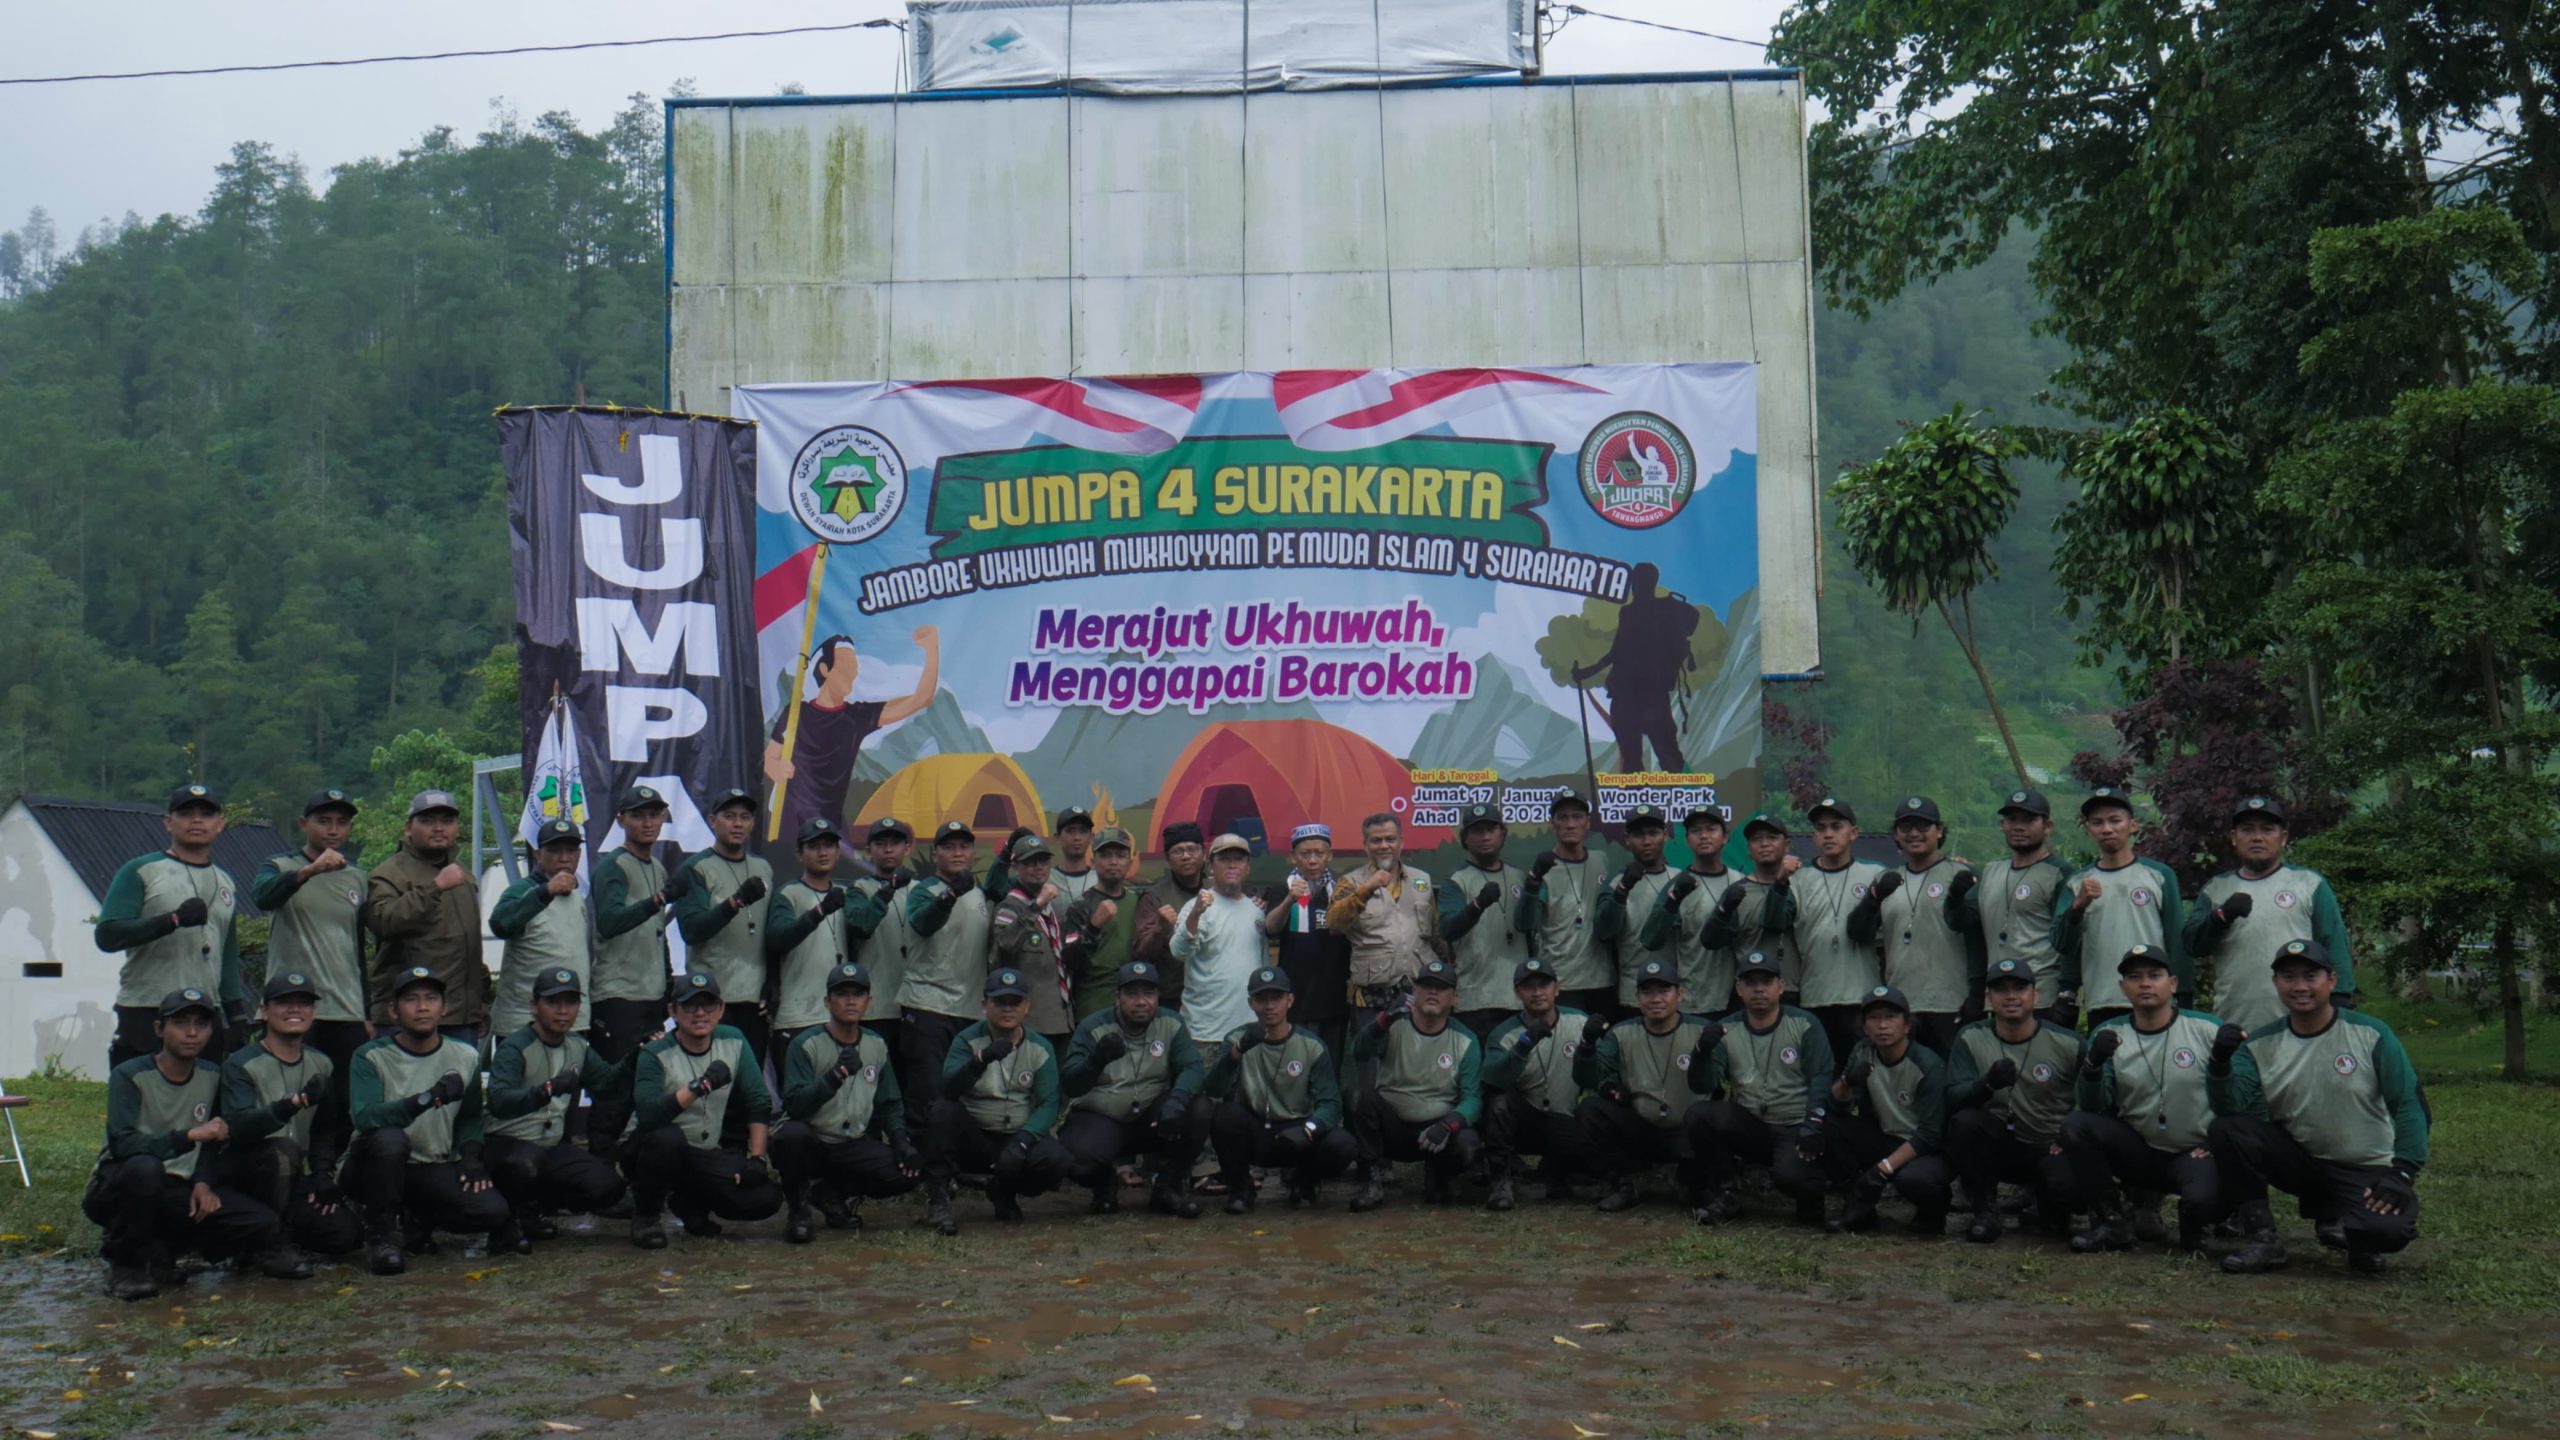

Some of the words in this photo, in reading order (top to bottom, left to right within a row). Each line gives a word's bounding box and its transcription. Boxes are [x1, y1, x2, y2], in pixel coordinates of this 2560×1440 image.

[968, 470, 1142, 531] JUMPA
[1156, 468, 1198, 516] 4
[1214, 465, 1504, 521] SURAKARTA
[1611, 487, 1664, 504] JUMPA
[800, 491, 817, 518] DEWAN
[814, 516, 845, 535] SYARIAH
[846, 524, 866, 535] KOTA
[866, 490, 897, 529] SURAKARTA
[861, 557, 973, 611] JAMBORE
[980, 540, 1096, 586] UKHUWAH
[1104, 532, 1259, 571] MUKHOYYAM
[1268, 531, 1370, 565] PEMUDA
[1378, 533, 1455, 571] ISLAM
[1485, 544, 1629, 600] SURAKARTA
[1035, 606, 1213, 657] Merajut
[1224, 600, 1445, 648] Ukhuwah,
[576, 434, 720, 853] JUMPA
[1009, 656, 1266, 710] Menggapai
[1278, 652, 1472, 698] Barokah
[1412, 770, 1435, 781] Hari
[1438, 770, 1447, 781] &
[1450, 769, 1490, 783] Tanggal
[1598, 773, 1639, 786] Tempat
[1641, 772, 1706, 784] Pelaksanaan
[1413, 786, 1469, 803] Jumat
[1471, 788, 1492, 803] 17
[1503, 787, 1565, 803] Janua
[1600, 789, 1669, 803] Wonder
[1673, 789, 1713, 803] Park
[1413, 810, 1458, 824] Ahad
